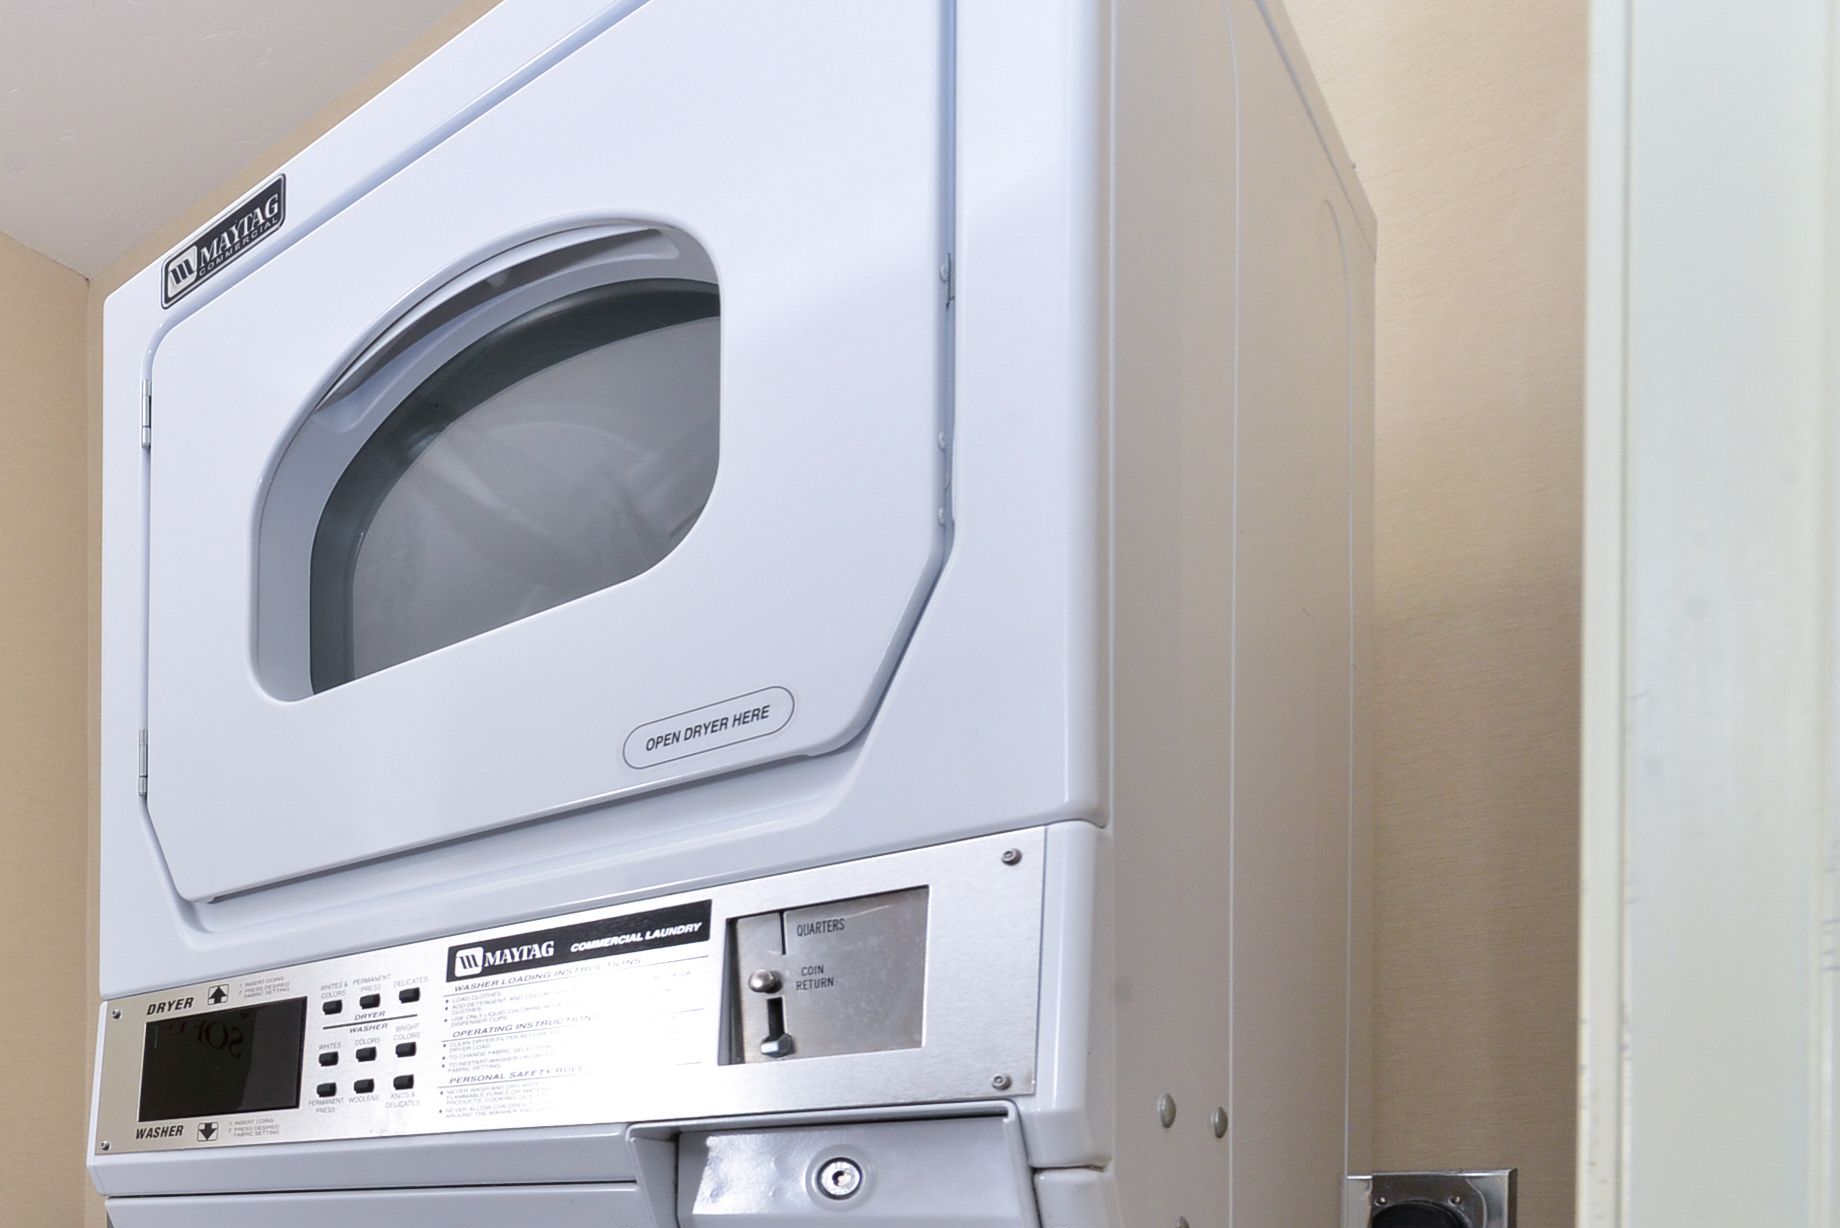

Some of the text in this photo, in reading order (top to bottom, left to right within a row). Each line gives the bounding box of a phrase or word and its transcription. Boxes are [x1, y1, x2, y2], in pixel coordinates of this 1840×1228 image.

[199, 193, 279, 268] MAYTAG
[199, 217, 278, 276] COMMERCIAL
[646, 704, 771, 751] OPEN DRYER HERE
[796, 918, 845, 937] QUARTERS
[483, 922, 702, 967] MAYTAG COMMERCIAL LAUNDRY
[801, 965, 825, 977] COIN
[353, 973, 391, 986] PERMANENT
[393, 976, 428, 987] DELICATES
[454, 980, 499, 992] WASHER
[501, 971, 551, 985] LOADING
[796, 977, 834, 990] RETURN
[321, 990, 346, 999] COLORS
[361, 984, 382, 992] PRESS
[146, 997, 194, 1015] DRYER
[354, 1011, 386, 1021] DRYER
[349, 1023, 388, 1034] WASHER
[452, 1024, 513, 1038] OPERATING
[355, 1037, 381, 1046] COLORS
[393, 1032, 421, 1041] COLORS
[449, 1073, 505, 1085] PERSONAL
[509, 1068, 551, 1079] SAFETY
[308, 1097, 344, 1107] PERMANENT
[136, 1125, 184, 1140] WASHER
